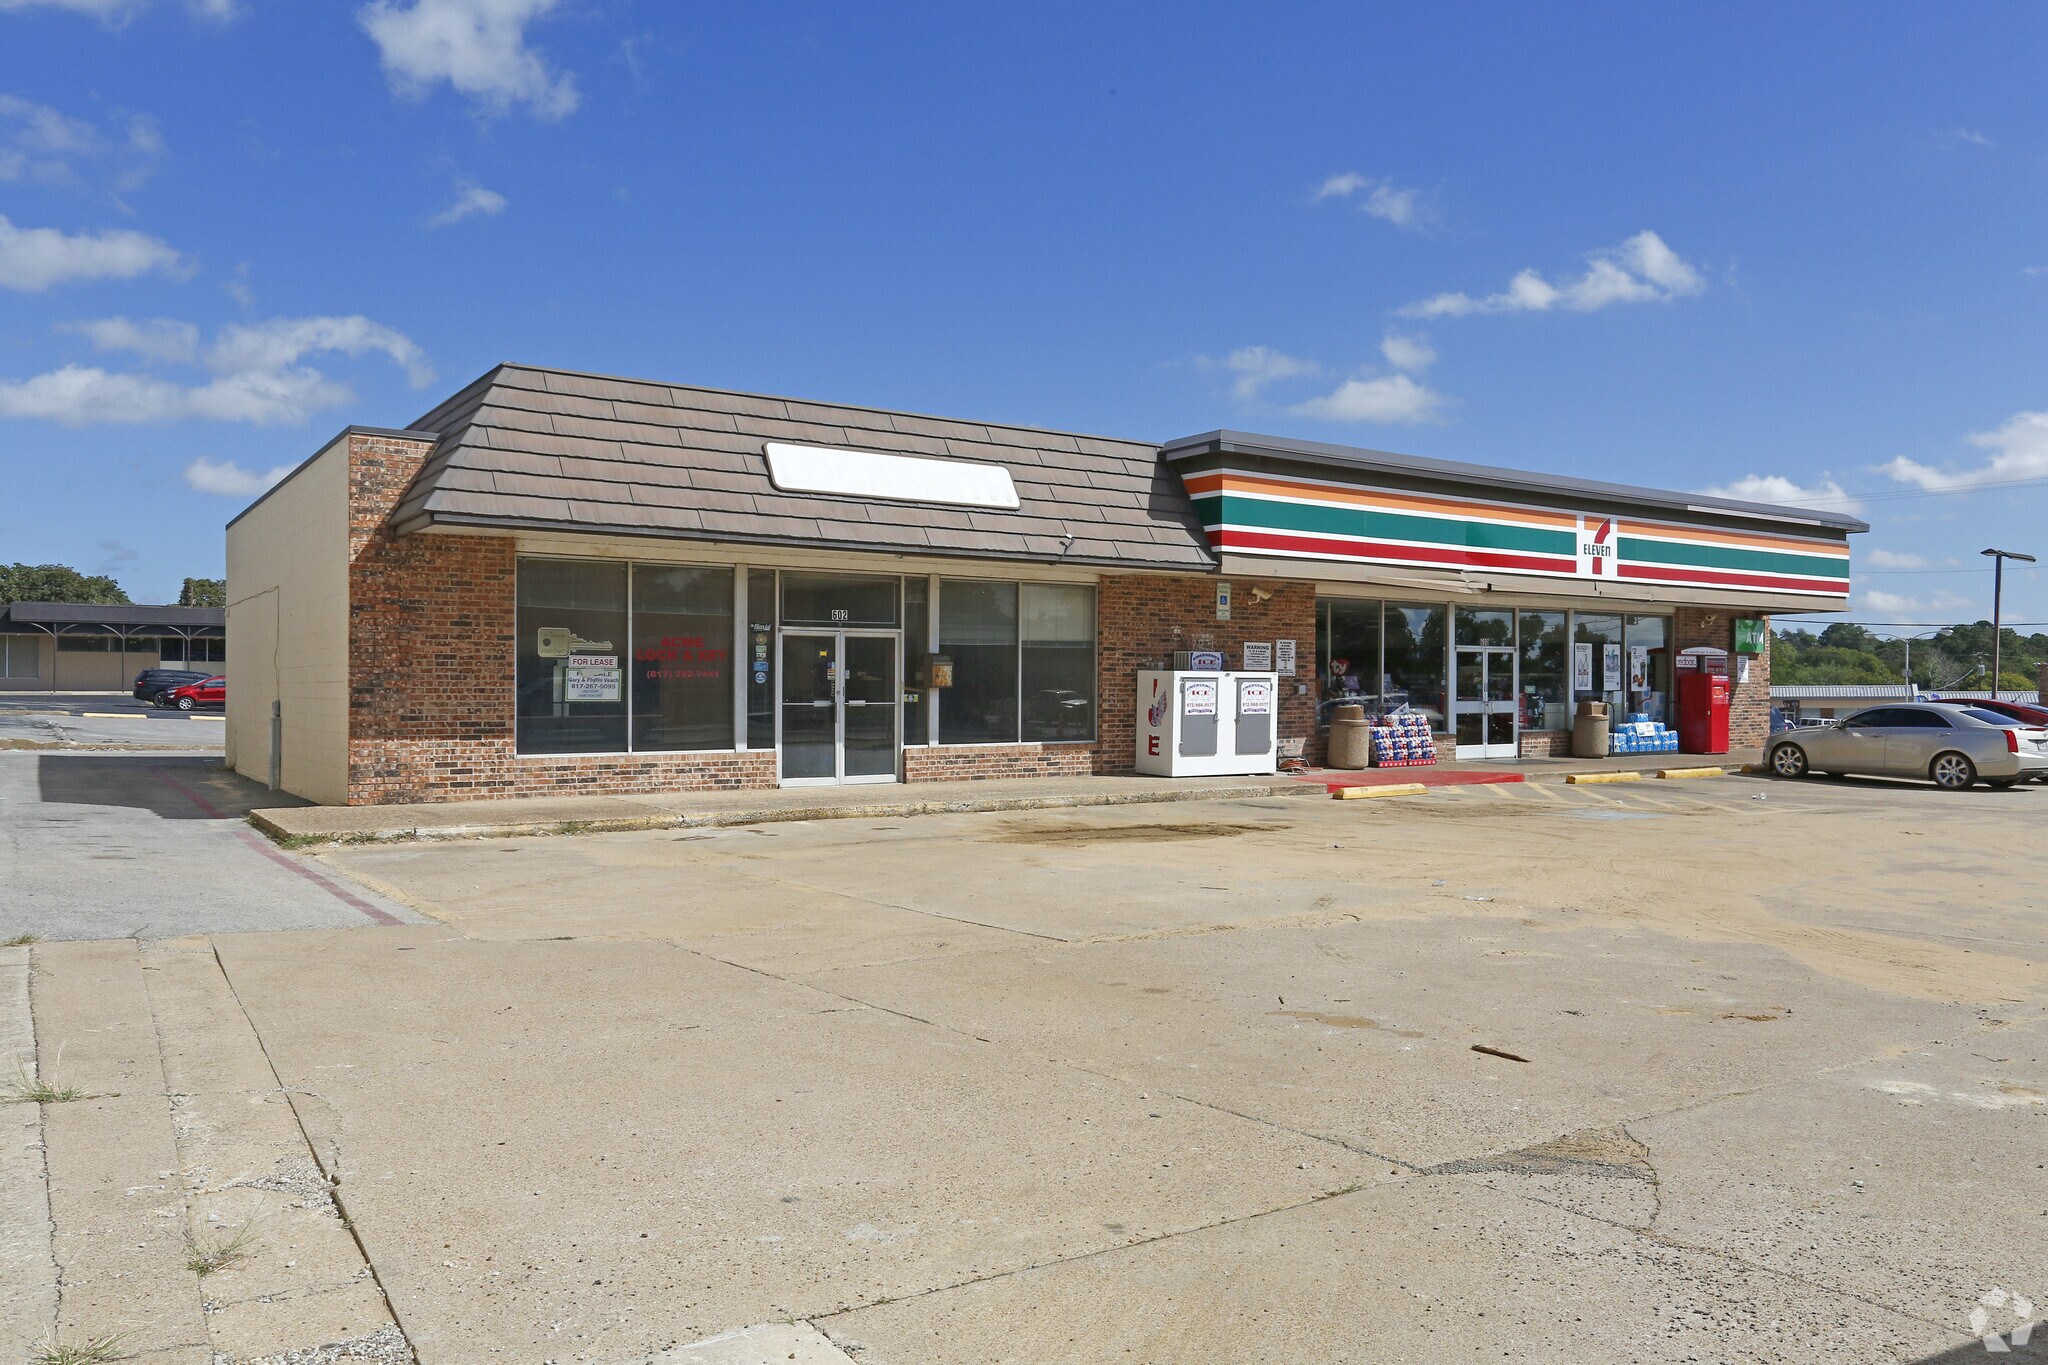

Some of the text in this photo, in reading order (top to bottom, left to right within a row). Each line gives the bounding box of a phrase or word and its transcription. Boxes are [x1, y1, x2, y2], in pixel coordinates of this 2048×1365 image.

[1592, 517, 1611, 575] 7
[832, 610, 848, 619] 602
[661, 636, 704, 648] ACME
[1746, 632, 1764, 645] ATM
[636, 649, 678, 661] LOCK
[697, 649, 727, 661] KEY
[1330, 660, 1347, 675] ty
